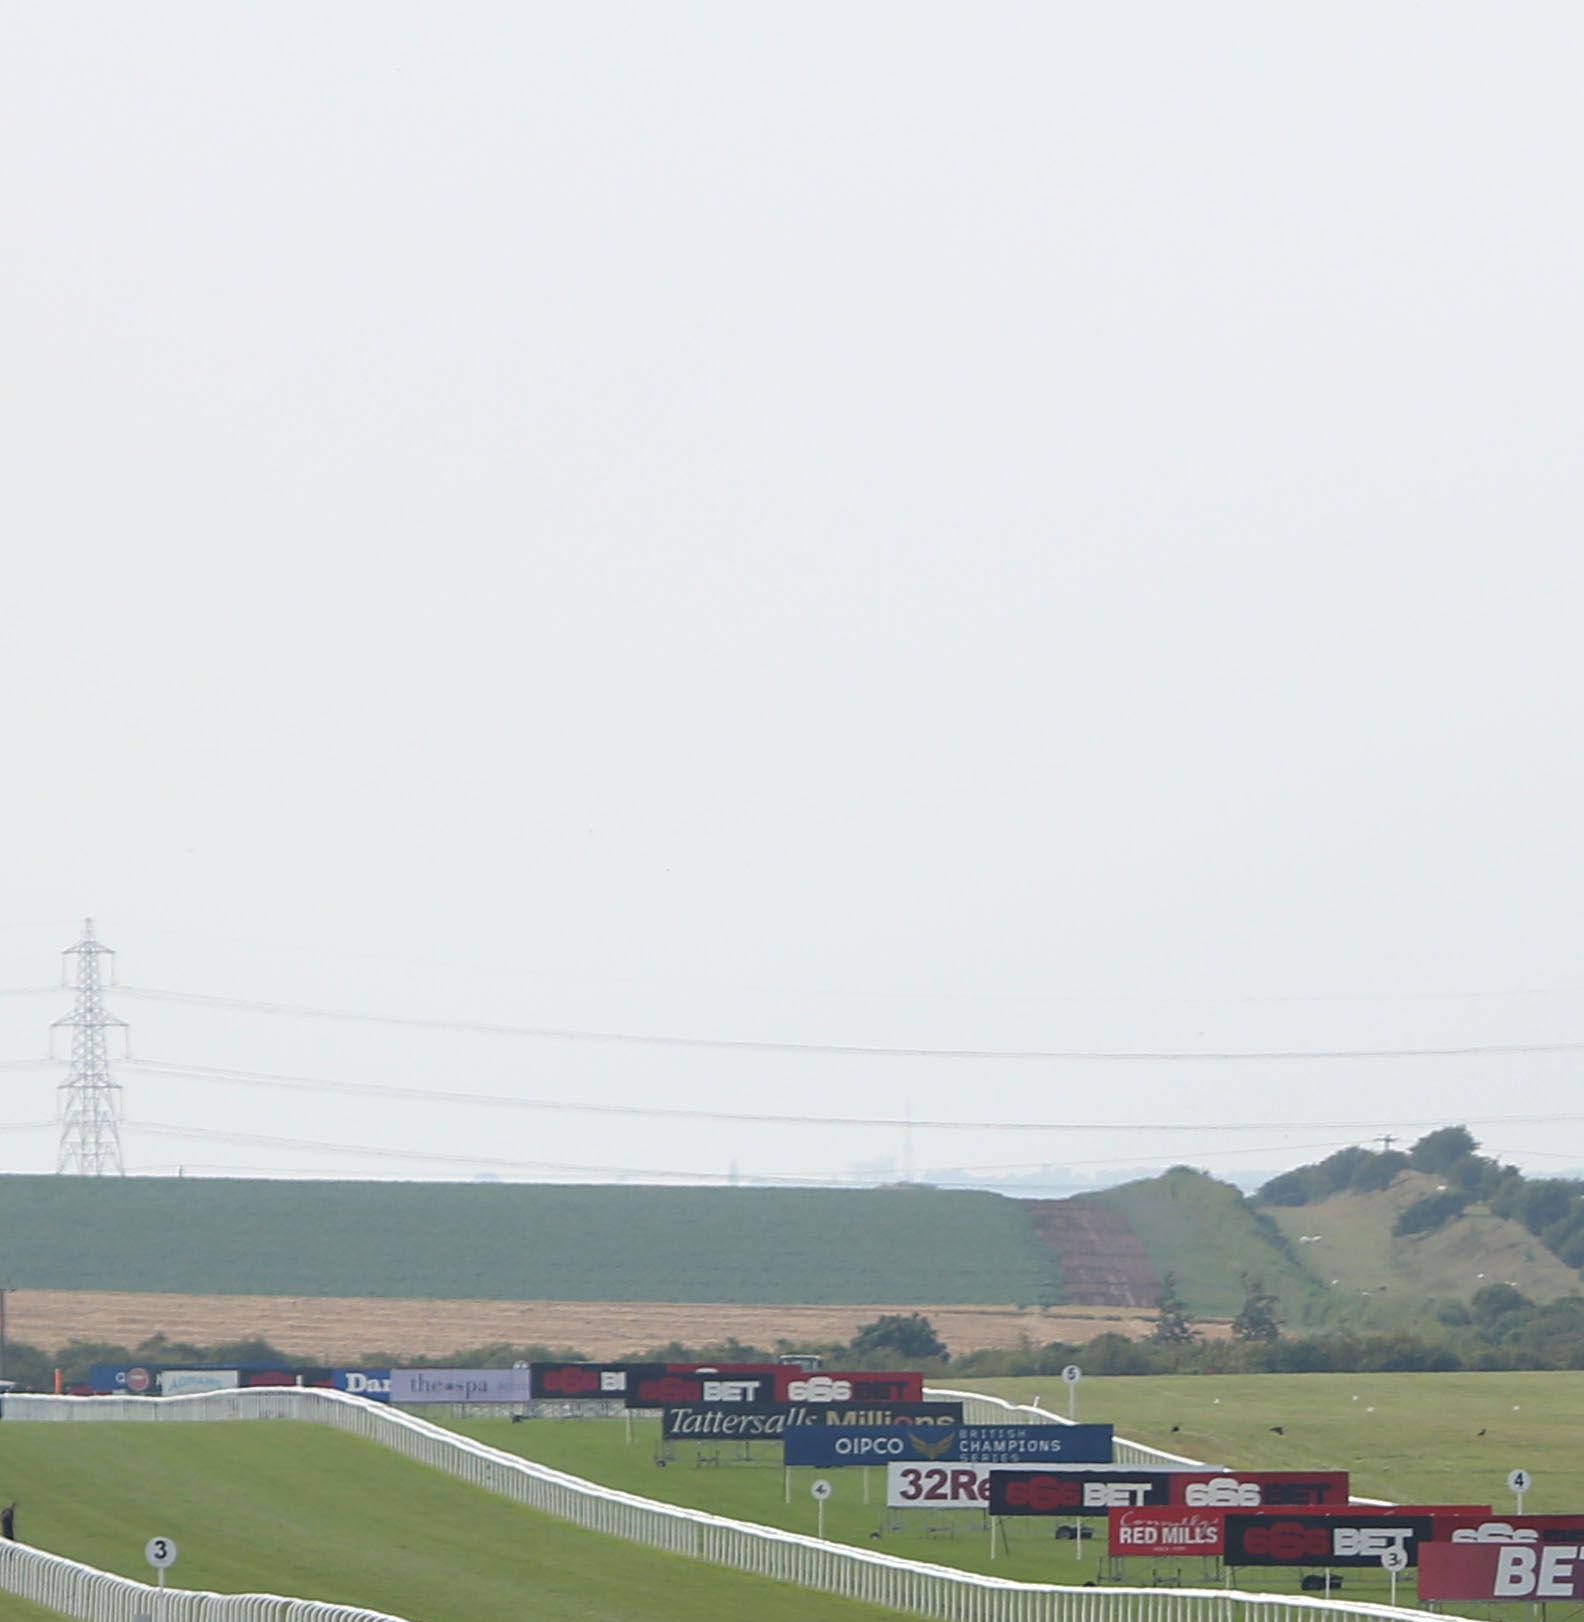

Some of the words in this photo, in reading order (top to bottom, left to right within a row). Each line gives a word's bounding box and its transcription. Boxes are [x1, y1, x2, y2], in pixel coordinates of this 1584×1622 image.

[1066, 1368, 1077, 1380] 5
[670, 1407, 817, 1434] Tattersalls
[959, 1429, 1026, 1439] BRITISH
[959, 1440, 1062, 1452] CHAMPIONS
[959, 1453, 1020, 1462] SERIES
[1514, 1472, 1524, 1487] 4
[1120, 1527, 1158, 1544] RED
[1162, 1527, 1219, 1544] MILLS
[155, 1540, 168, 1559] 3
